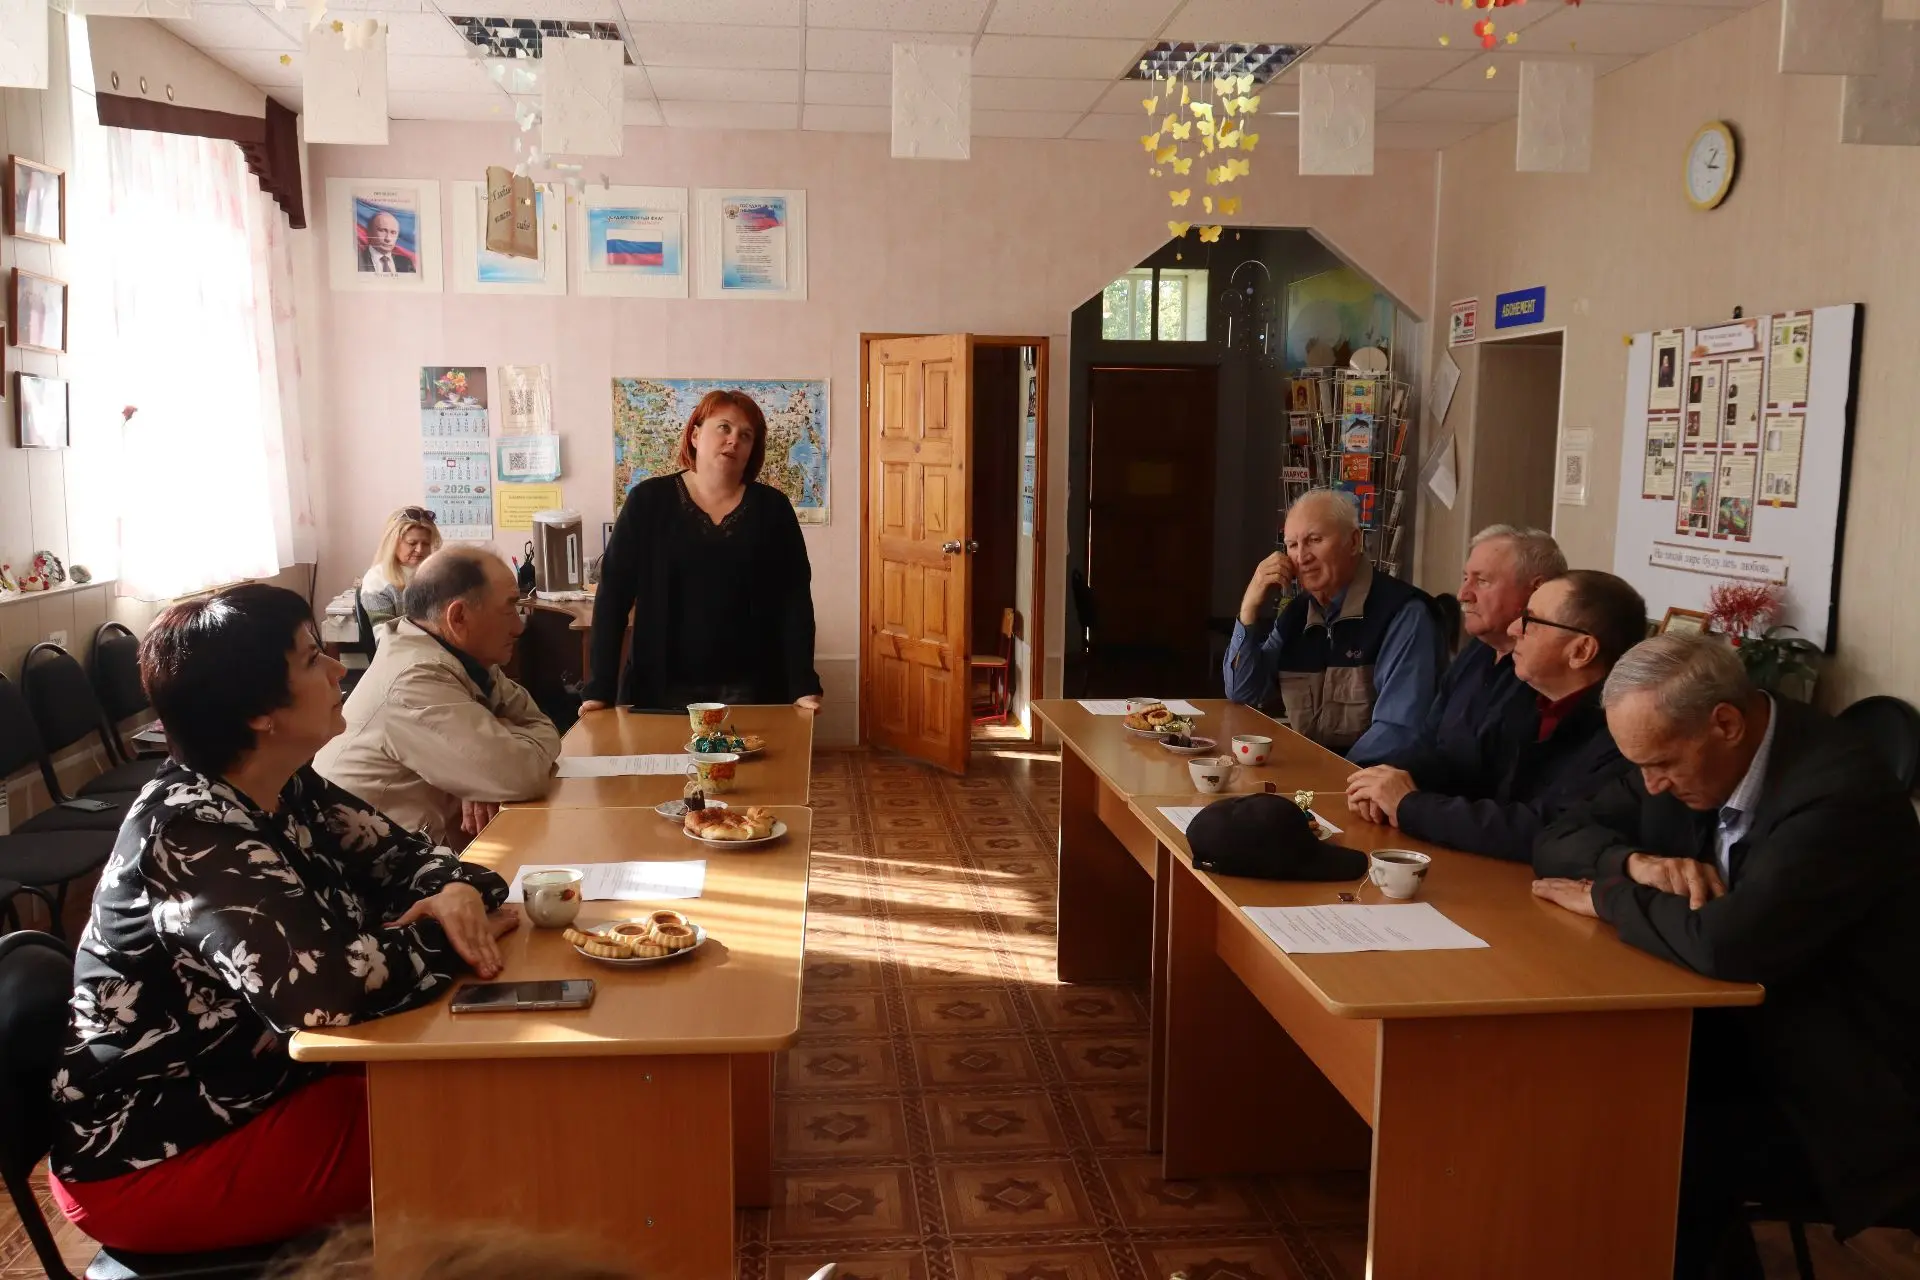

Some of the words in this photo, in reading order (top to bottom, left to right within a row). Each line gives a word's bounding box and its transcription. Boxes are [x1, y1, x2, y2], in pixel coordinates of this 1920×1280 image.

[1502, 299, 1536, 318] АБОНЕМЕНТ
[1284, 470, 1308, 478] МАРУСЯ
[444, 484, 471, 494] 2026
